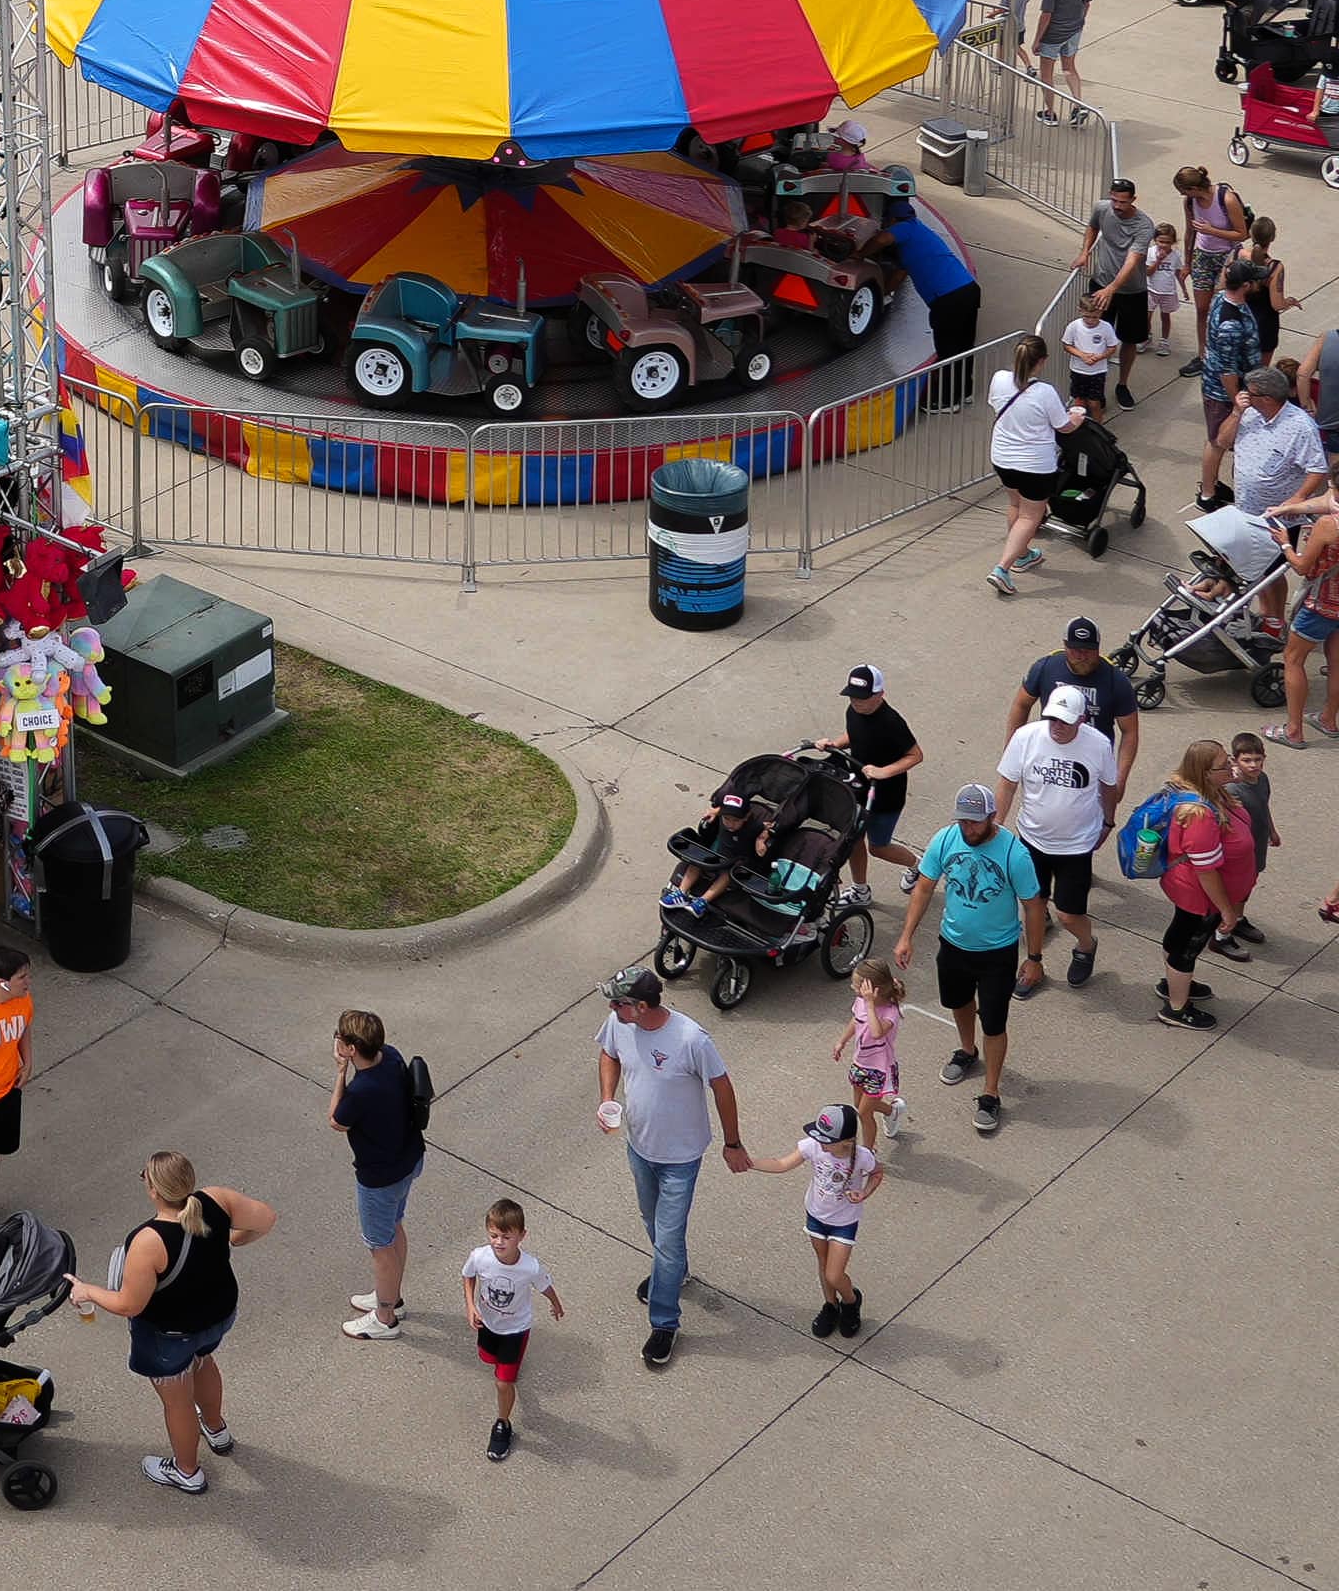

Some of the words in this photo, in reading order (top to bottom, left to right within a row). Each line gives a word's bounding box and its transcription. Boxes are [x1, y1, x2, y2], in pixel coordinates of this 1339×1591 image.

[22, 714, 54, 727] CHOICE
[1050, 757, 1074, 770] THE
[1032, 765, 1074, 779] NORTH
[1042, 776, 1073, 788] FACE
